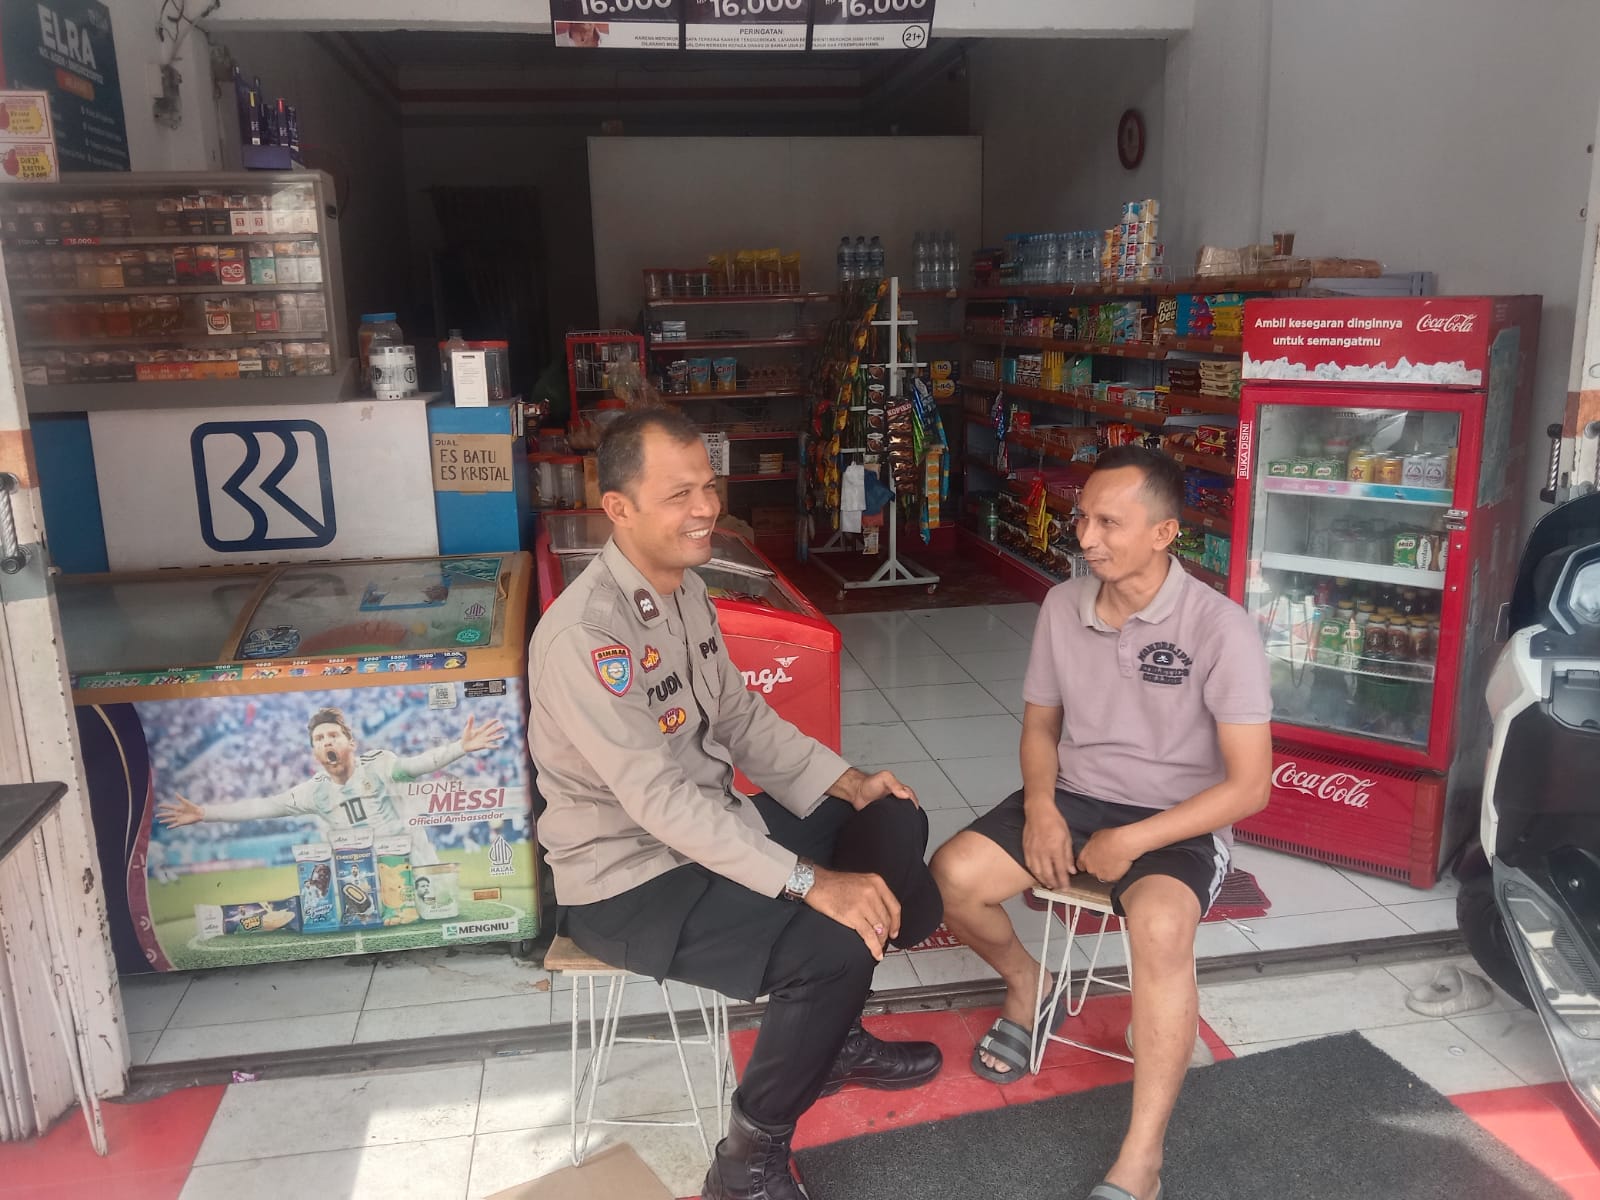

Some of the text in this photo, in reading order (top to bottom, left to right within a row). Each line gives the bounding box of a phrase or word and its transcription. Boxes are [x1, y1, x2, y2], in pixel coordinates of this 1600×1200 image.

[38, 3, 97, 70] ELRA
[1157, 300, 1177, 314] Pota
[1158, 310, 1176, 323] bee
[1254, 317, 1403, 330] Ambil kesegaran dinginnya
[1416, 313, 1478, 333] Coca-Cola
[1272, 335, 1381, 348] untuk semangatmu
[886, 403, 912, 417] KOPIKO
[435, 439, 459, 447] JUAL
[1239, 423, 1250, 477] BUKA DISINI
[440, 449, 496, 464] ES BATU
[441, 465, 511, 481] ES KRISTAL
[740, 667, 793, 694] ngs
[408, 780, 465, 796] LIONEL
[1271, 761, 1379, 808] Coca-Cola
[428, 788, 505, 813] MESSI
[339, 796, 368, 824] 10
[408, 811, 505, 826] Official Ambassador
[458, 923, 510, 935] MENGNIU
